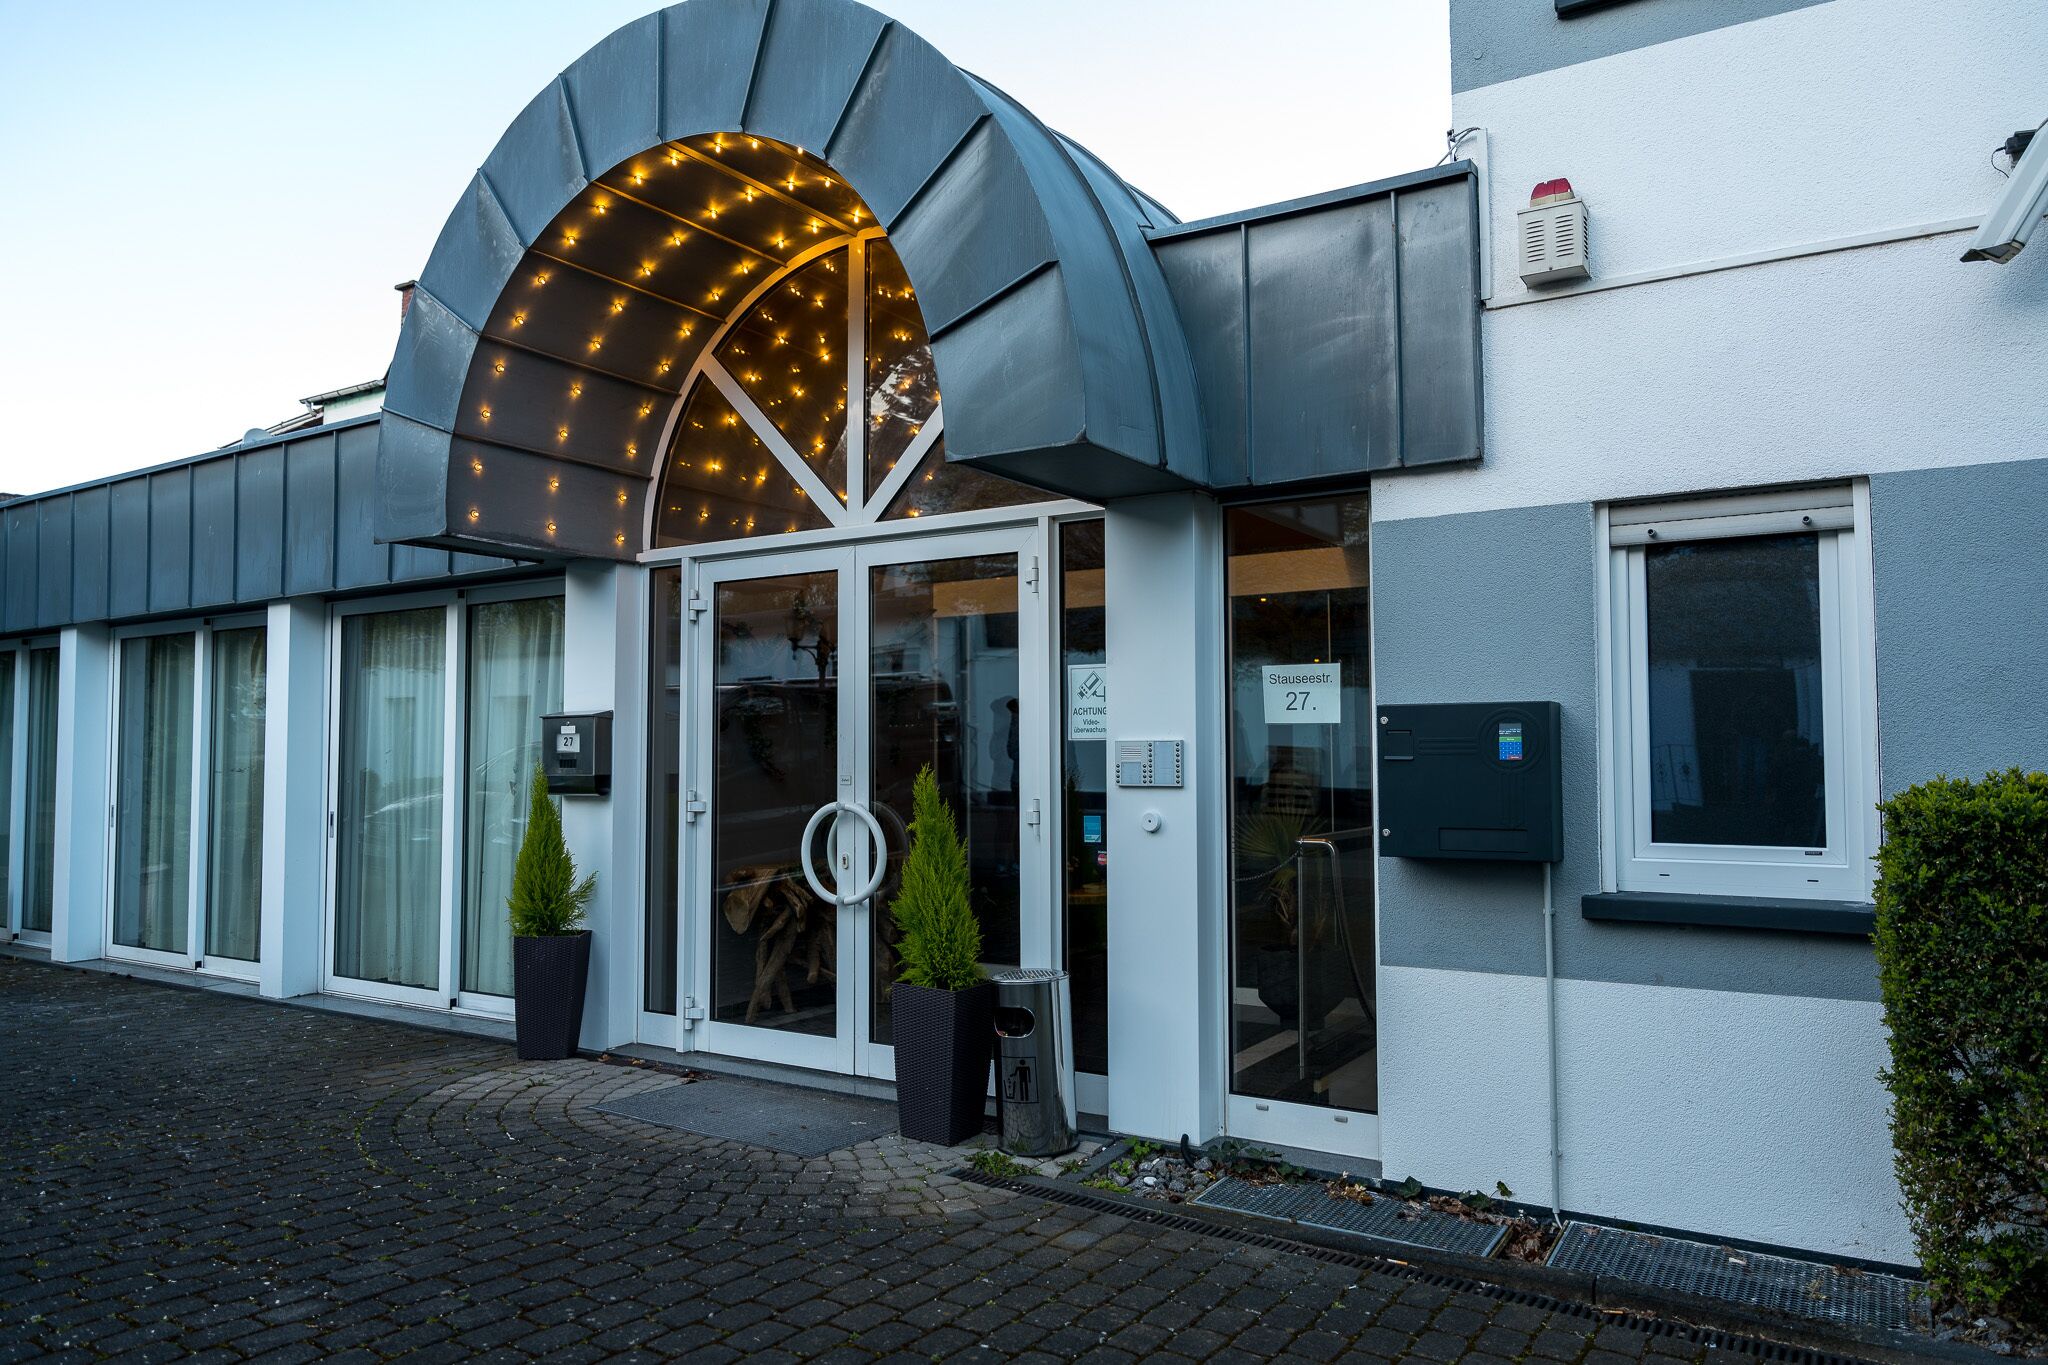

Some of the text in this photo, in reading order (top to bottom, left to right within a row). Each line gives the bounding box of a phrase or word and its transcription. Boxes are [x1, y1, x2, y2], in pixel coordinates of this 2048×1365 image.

[1269, 673, 1333, 685] Stauseestr.
[1285, 691, 1316, 711] 27.
[563, 736, 574, 747] 27
